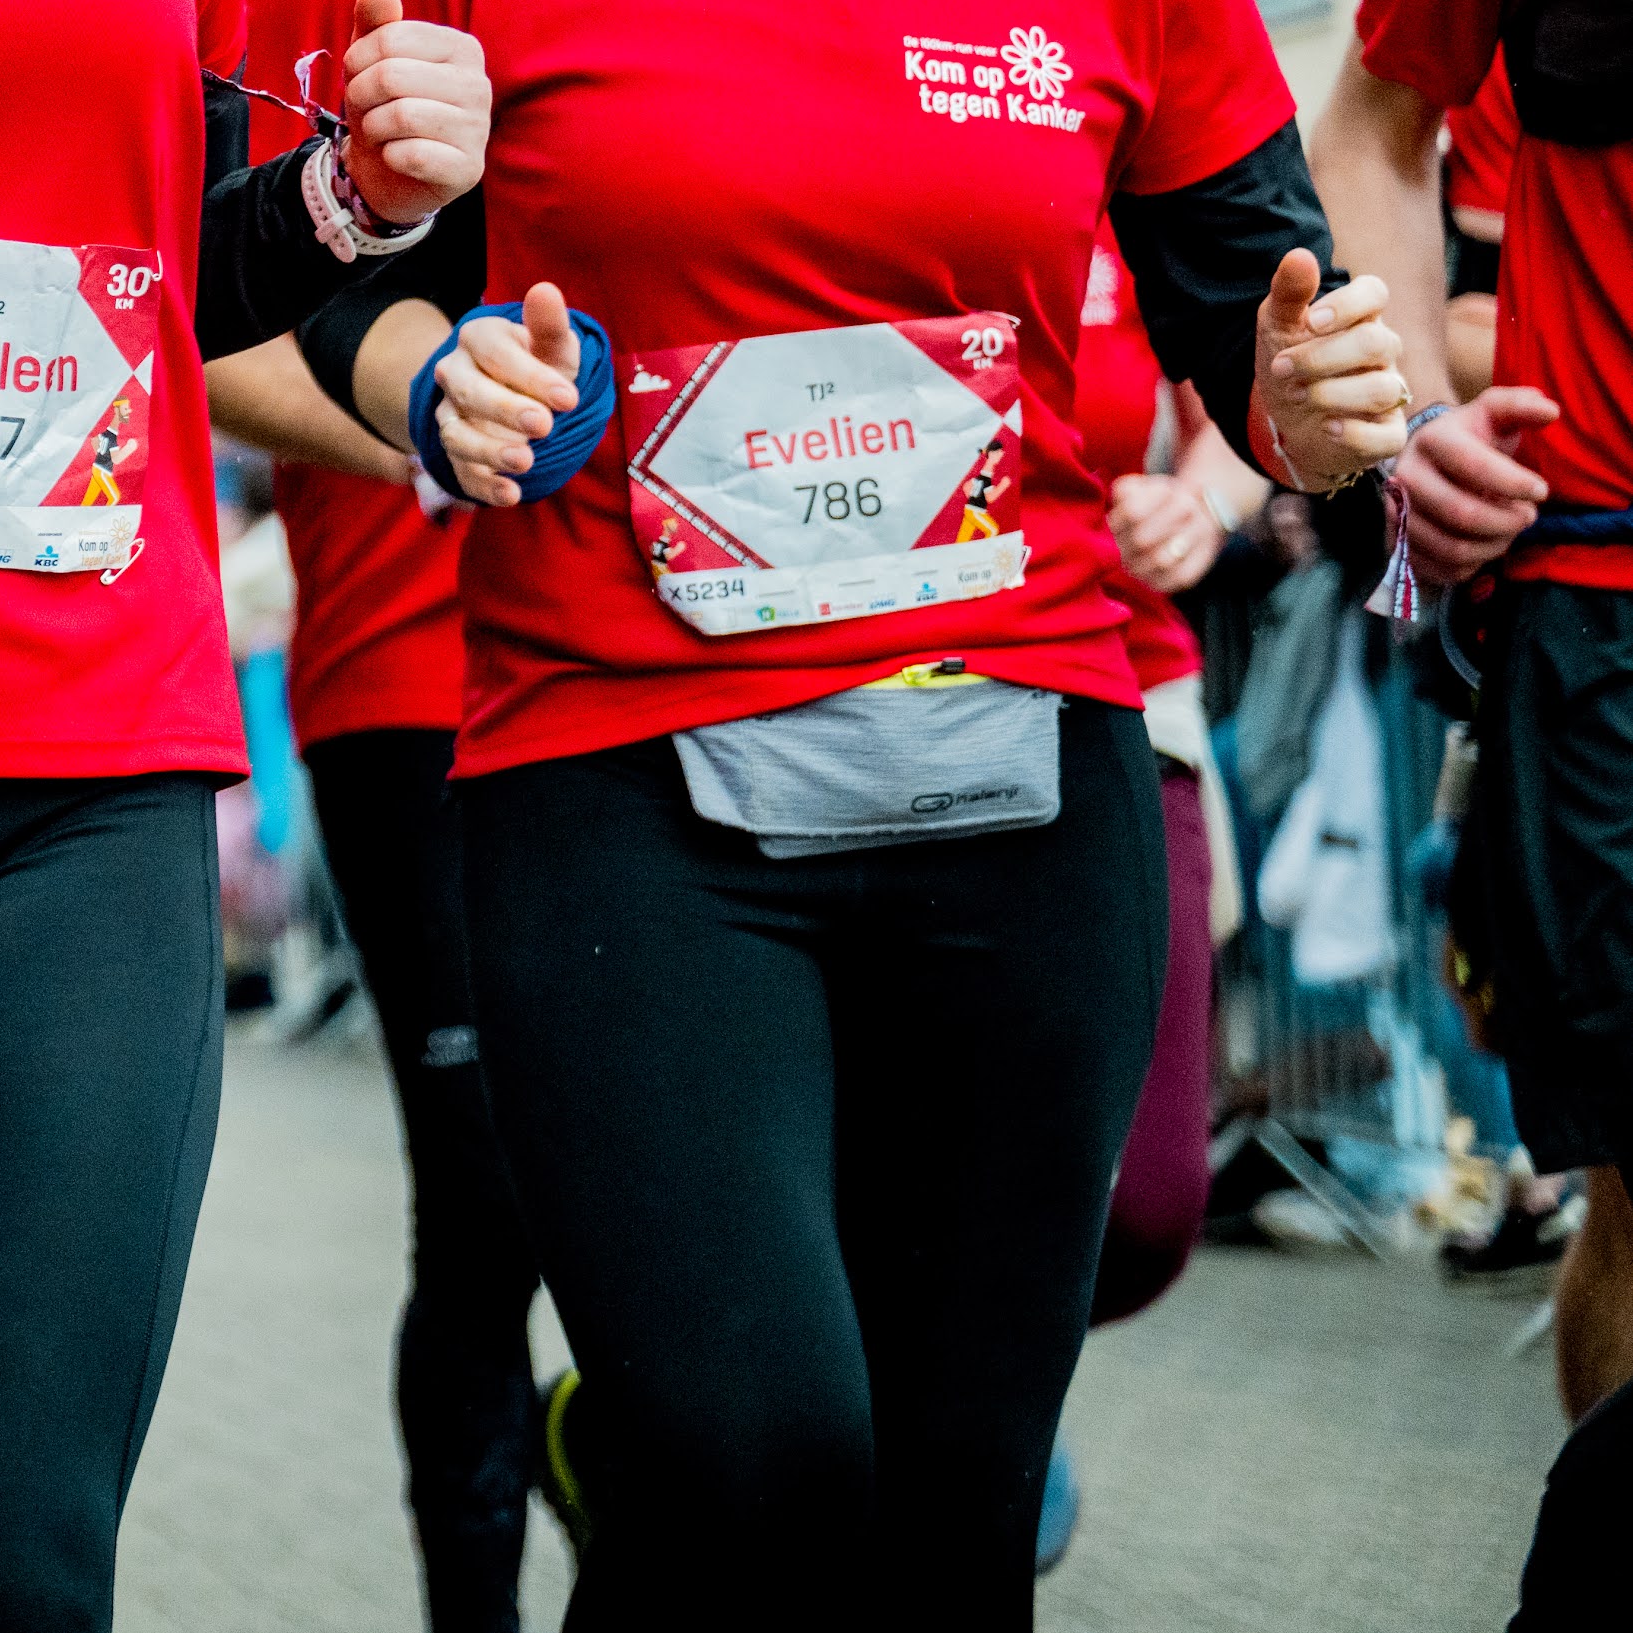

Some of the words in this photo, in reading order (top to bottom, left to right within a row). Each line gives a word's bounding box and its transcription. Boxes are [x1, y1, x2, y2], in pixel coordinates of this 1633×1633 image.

[904, 50, 967, 85] Kom
[973, 65, 1006, 96] op
[919, 83, 1001, 123] tegen
[1006, 93, 1086, 133] Kanker
[107, 263, 151, 297] 30
[115, 298, 134, 310] KM
[960, 327, 1004, 361] 20
[973, 357, 994, 370] KM
[744, 415, 916, 470] Evelien
[794, 477, 882, 524] 786
[34, 559, 59, 567] KBC
[78, 539, 97, 552] Kom
[99, 541, 109, 554] op
